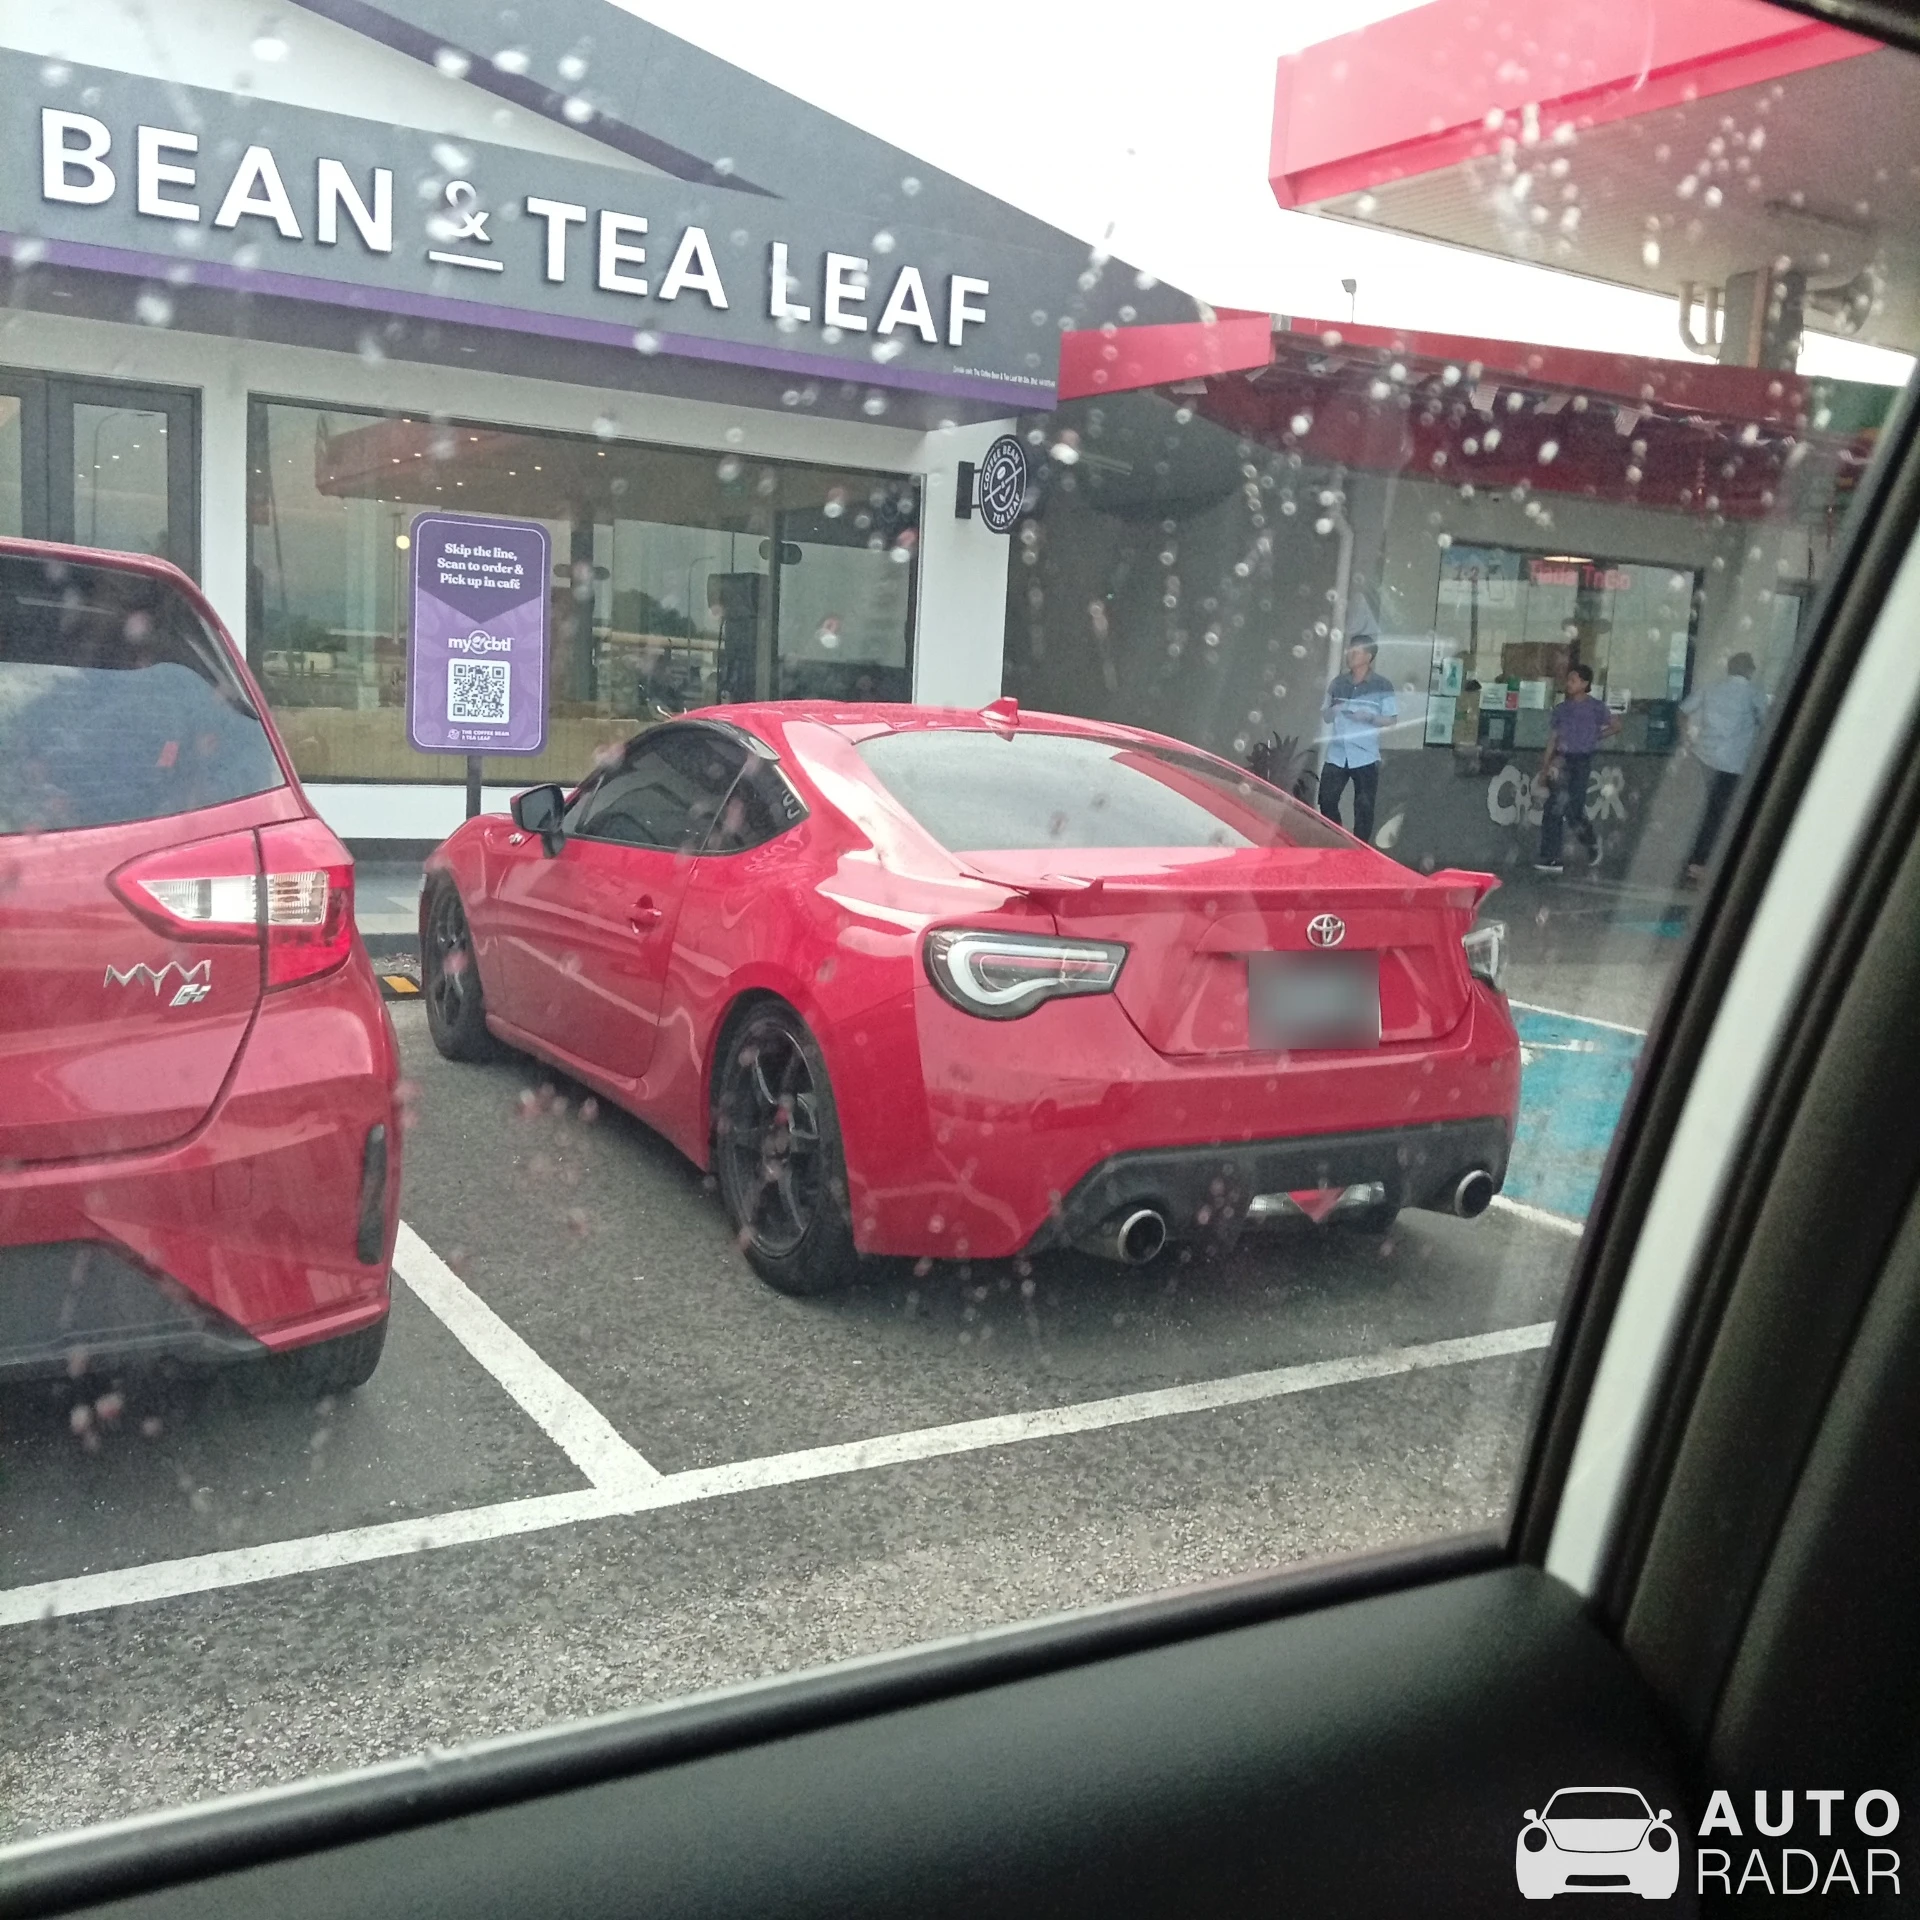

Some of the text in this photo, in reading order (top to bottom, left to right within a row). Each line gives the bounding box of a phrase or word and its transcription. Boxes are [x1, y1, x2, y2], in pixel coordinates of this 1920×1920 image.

[41, 107, 394, 253] BEAN
[526, 195, 729, 310] TEA
[769, 240, 990, 347] LEAF
[984, 445, 1021, 491] COFFEE BEAN
[992, 493, 1021, 524] TEA LEAF
[445, 543, 518, 561] Skip the line,
[437, 557, 524, 575] Scan to order &
[440, 572, 521, 589] Pick up in café
